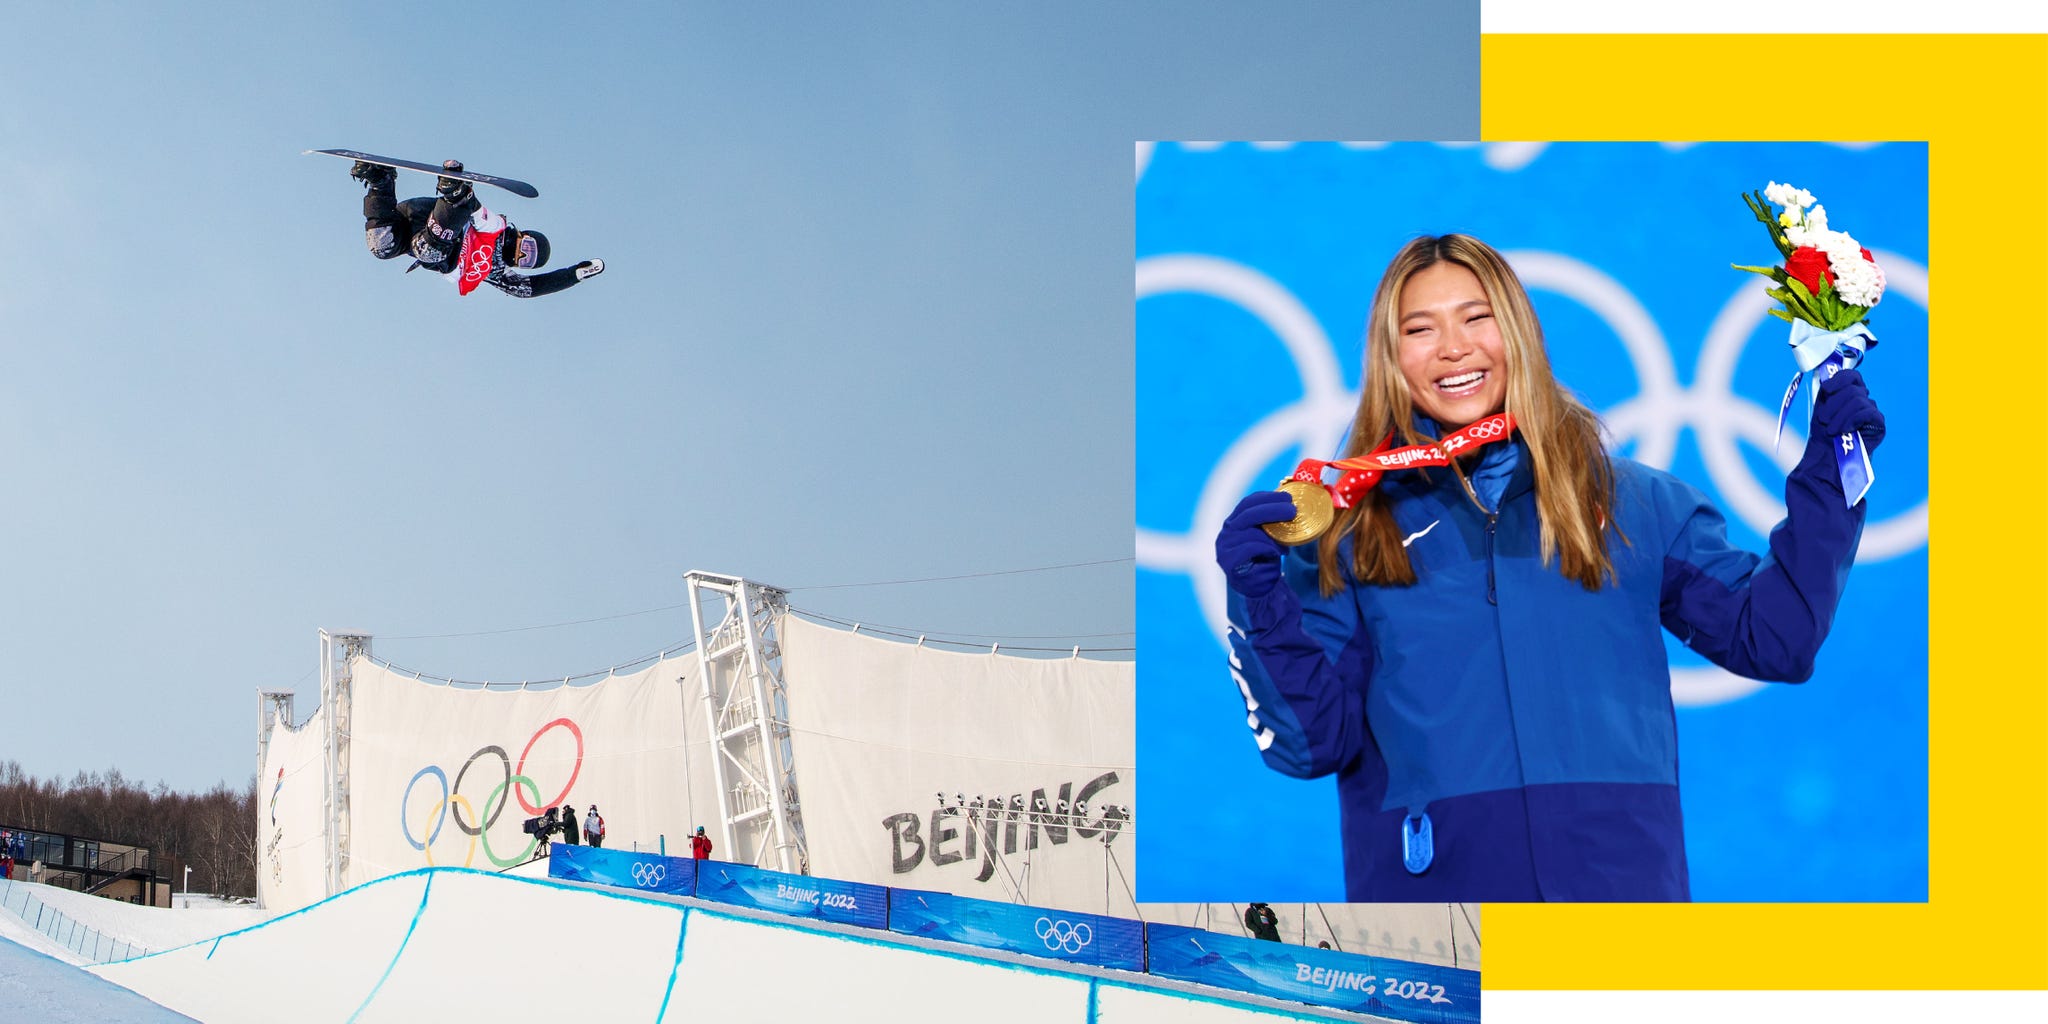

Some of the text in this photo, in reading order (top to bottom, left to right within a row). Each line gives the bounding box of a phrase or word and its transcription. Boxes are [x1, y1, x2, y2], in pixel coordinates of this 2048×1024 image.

[582, 265, 600, 275] USA
[1376, 449, 1431, 466] BEIJING
[882, 771, 1123, 883] BEIJING
[777, 884, 859, 910] BEIJING 2022
[1295, 963, 1453, 1005] BEIJING 2022
